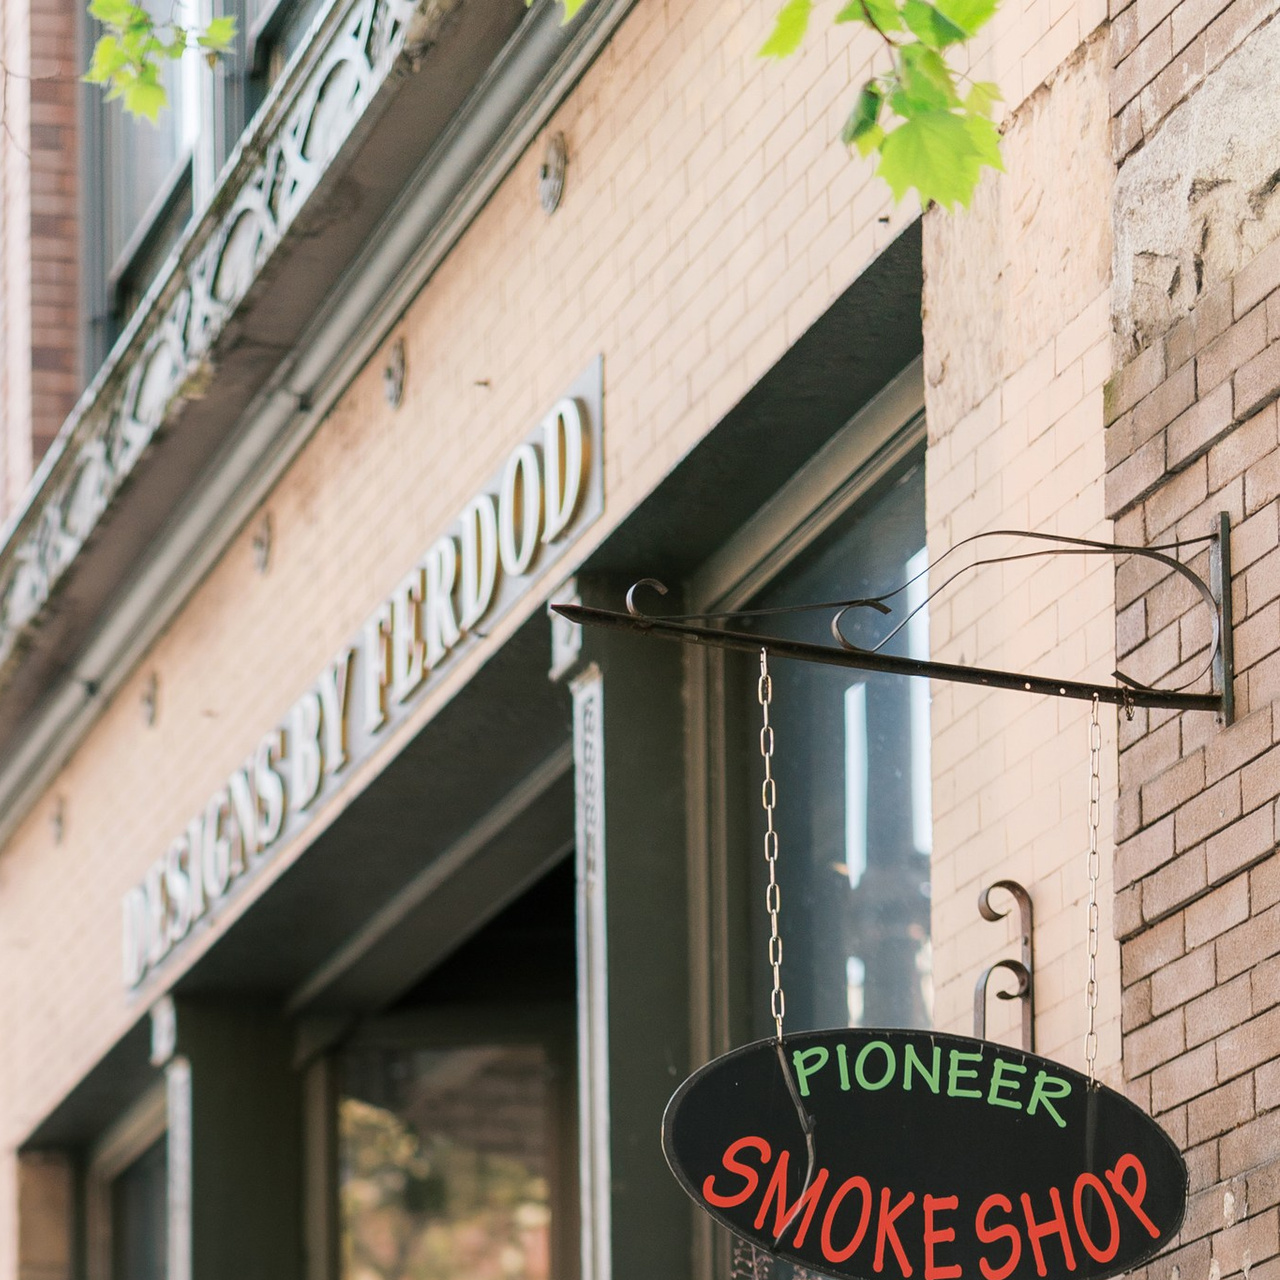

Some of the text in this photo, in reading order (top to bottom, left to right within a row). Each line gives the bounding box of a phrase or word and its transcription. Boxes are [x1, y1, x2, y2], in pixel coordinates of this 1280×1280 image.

[289, 647, 355, 814] BY
[364, 397, 588, 735] FERDOD
[792, 1040, 1072, 1129] PIONEER
